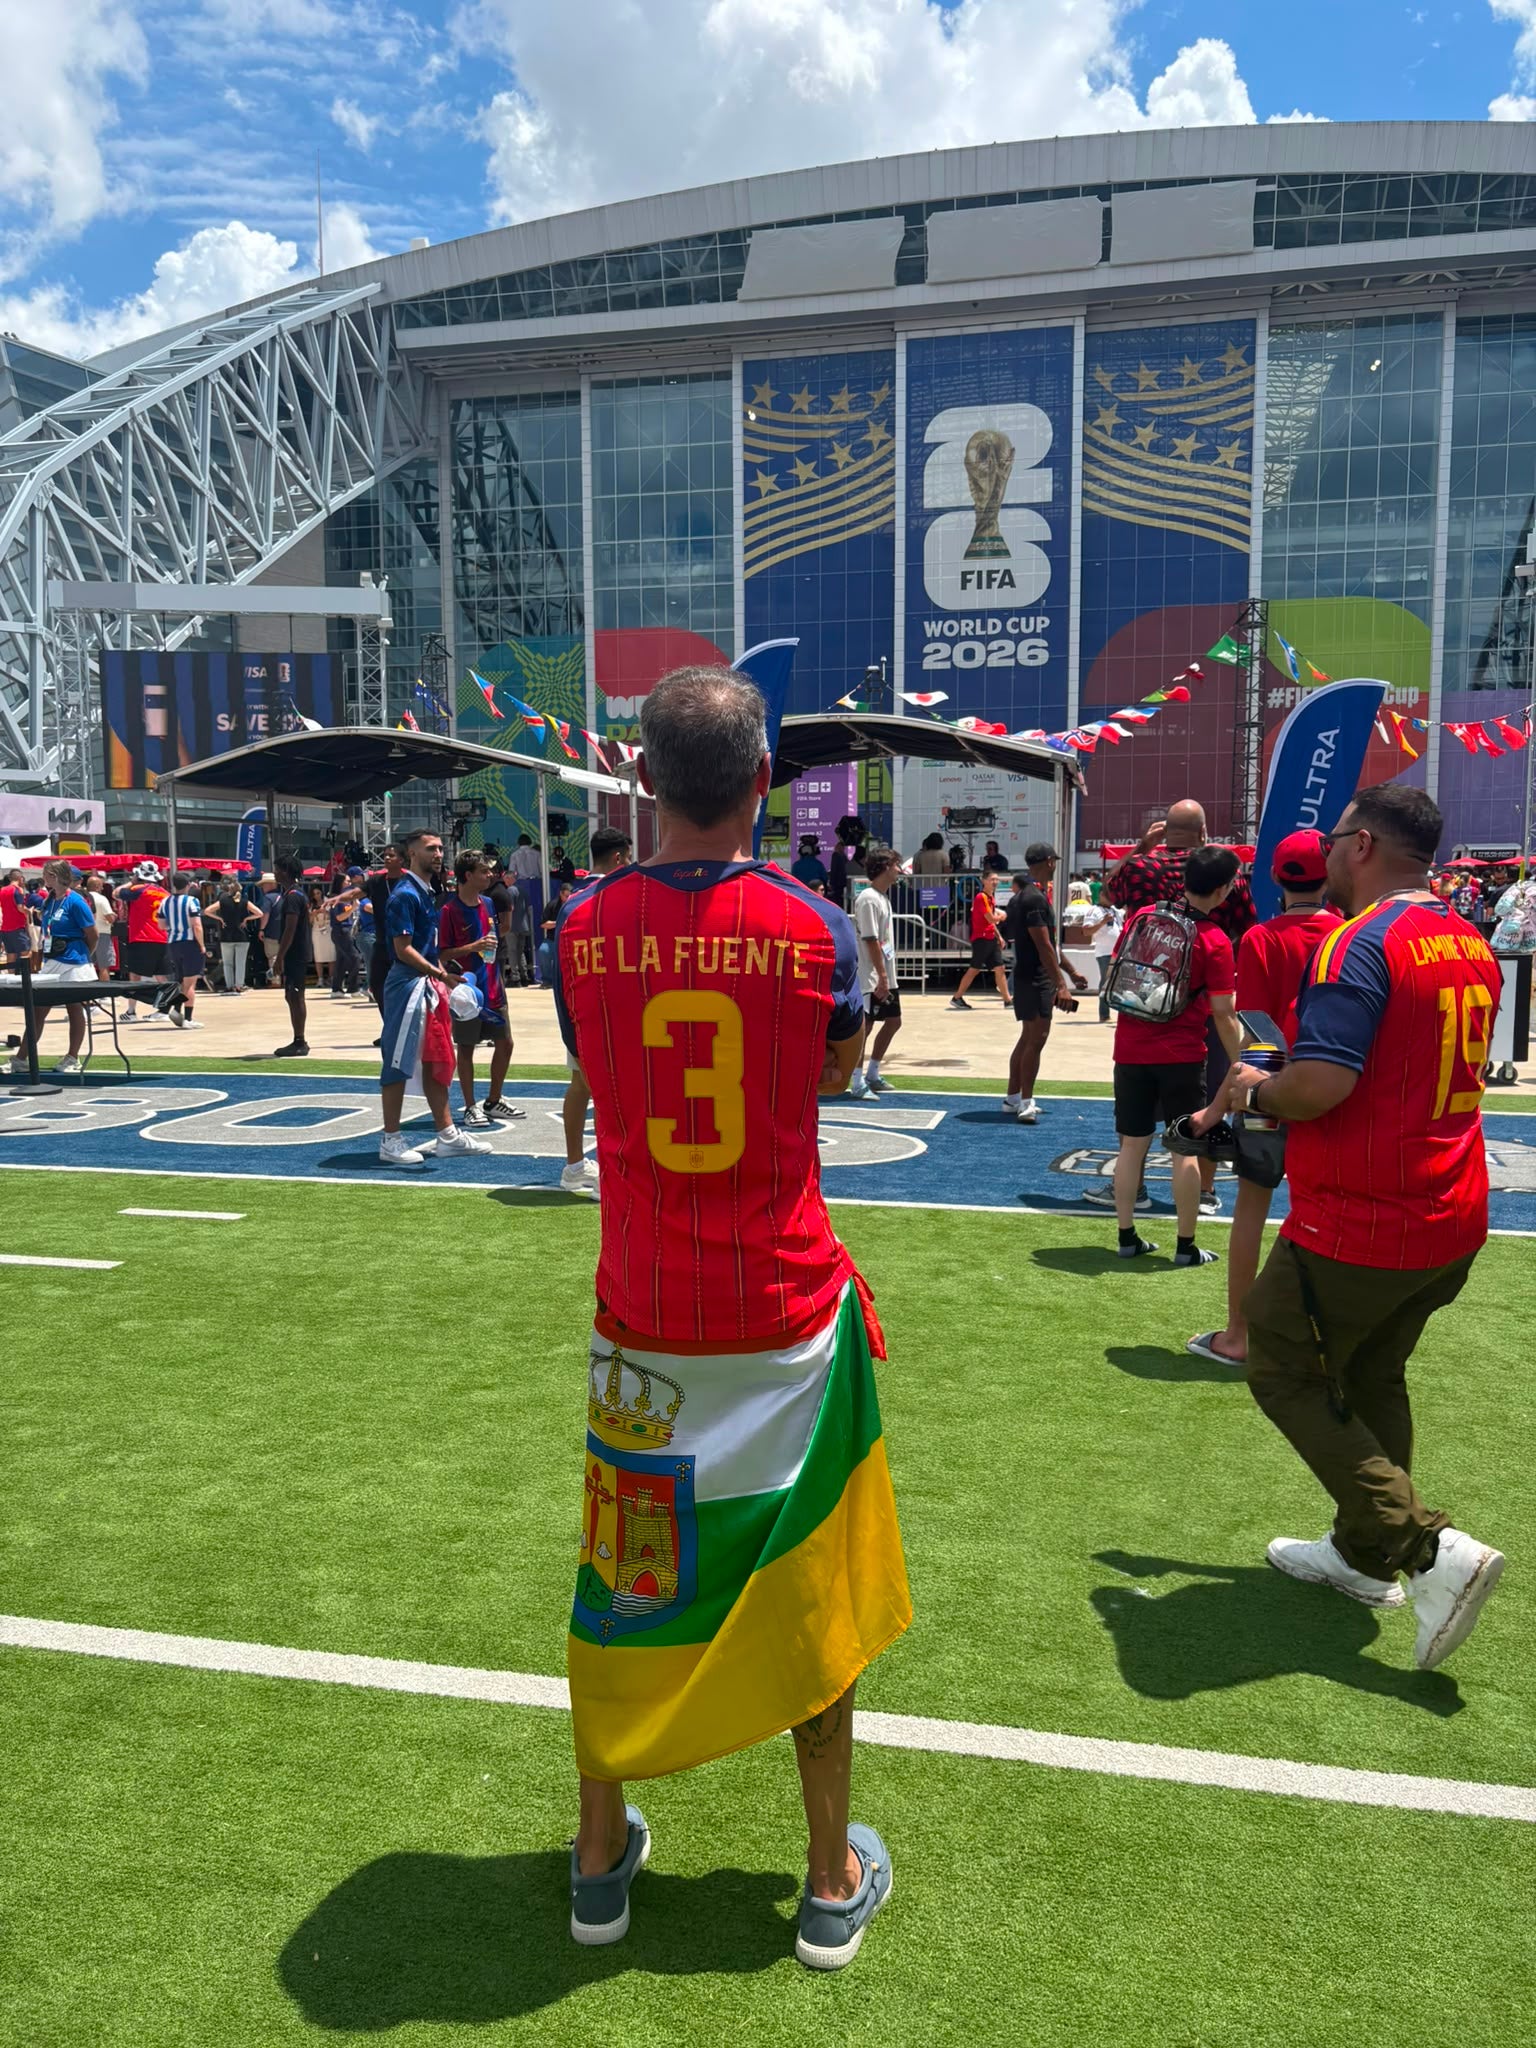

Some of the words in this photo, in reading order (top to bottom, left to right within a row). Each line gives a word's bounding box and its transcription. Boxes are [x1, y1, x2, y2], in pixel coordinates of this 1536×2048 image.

[961, 569, 1016, 590] FIFA
[923, 618, 1003, 638] WORLD
[1006, 616, 1050, 635] CUP
[922, 638, 1050, 670] 2026
[1007, 773, 1029, 782] VISA
[1296, 726, 1340, 829] ULTRA
[246, 824, 256, 860] ULTRA
[1071, 889, 1082, 901] 20
[573, 936, 606, 976] DE
[616, 935, 662, 974] LA
[674, 936, 810, 979] FUENTE
[1407, 933, 1462, 966] LAMINE
[1456, 934, 1495, 962] YAMA
[1432, 984, 1493, 1120] 19
[642, 990, 746, 1174] 3
